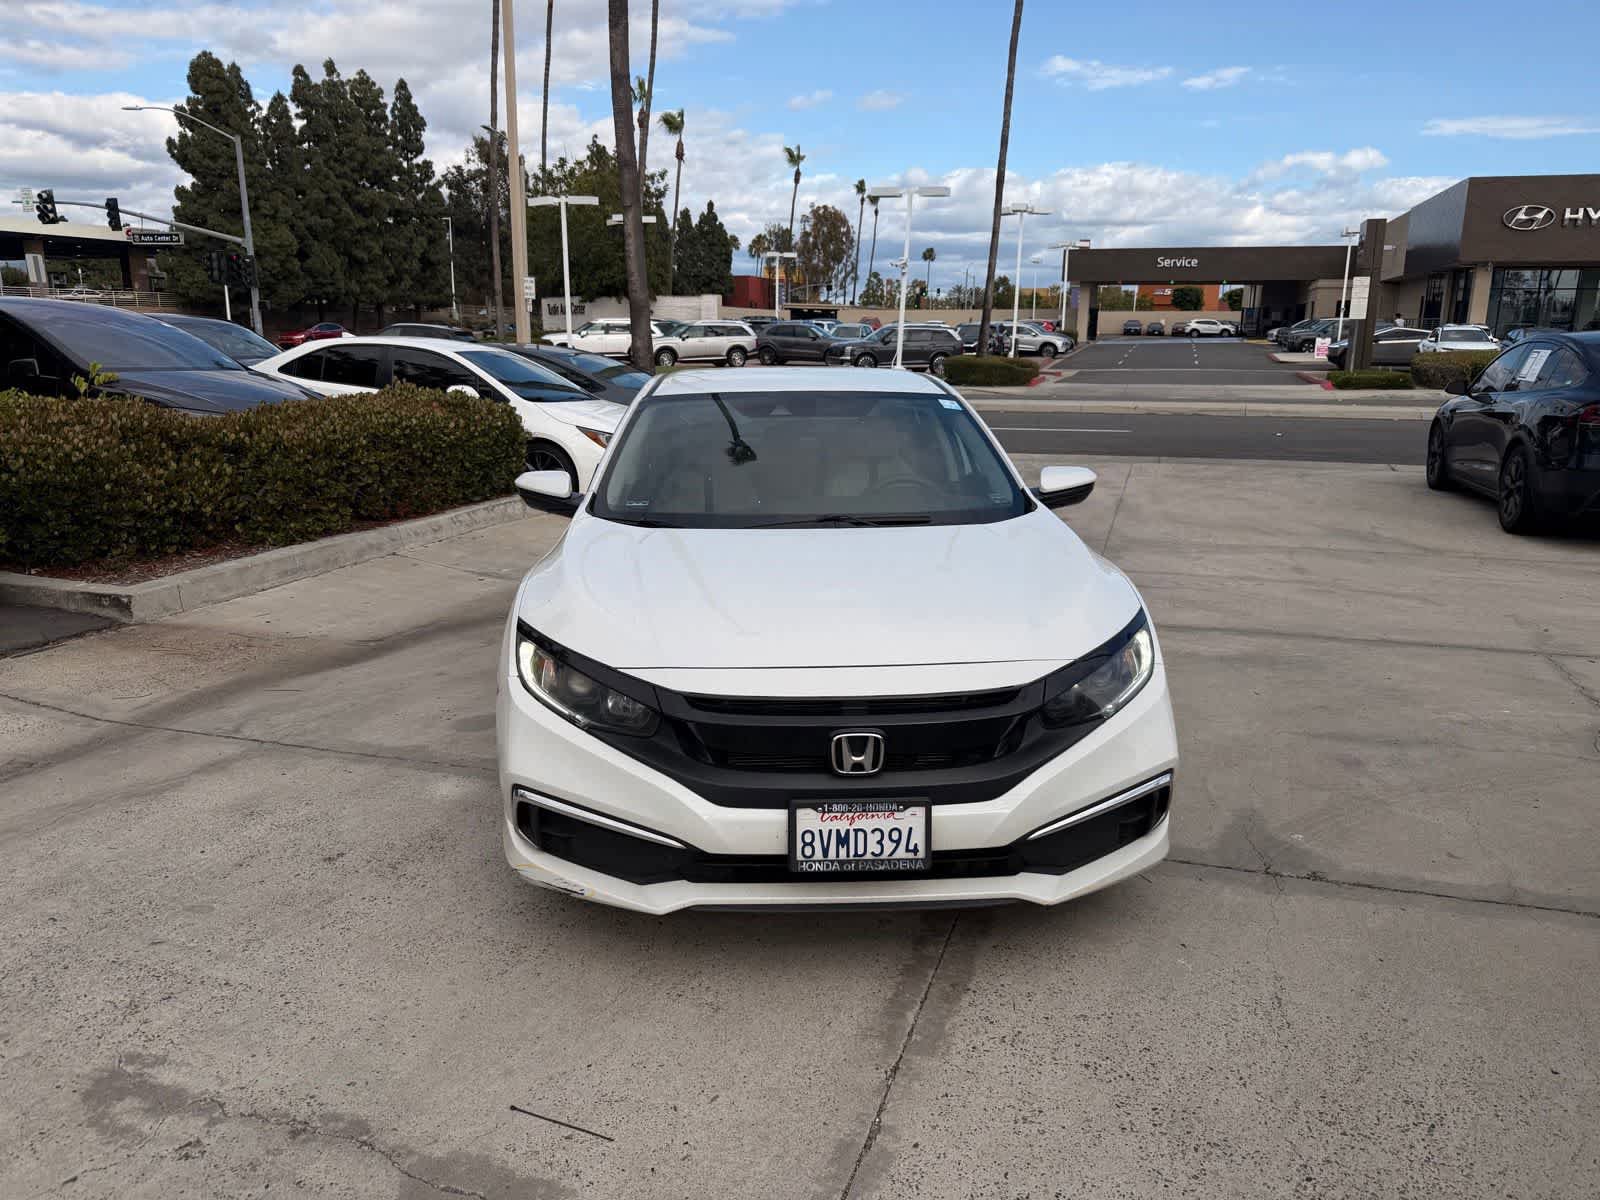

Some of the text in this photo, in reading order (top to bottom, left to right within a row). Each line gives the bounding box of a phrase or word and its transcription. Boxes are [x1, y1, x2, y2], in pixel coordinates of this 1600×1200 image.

[141, 234, 153, 242] Auto
[154, 234, 171, 242] Center
[1156, 256, 1199, 268] Service
[800, 827, 920, 860] 8VMD394
[798, 860, 925, 872] HONDA of PASADENA
